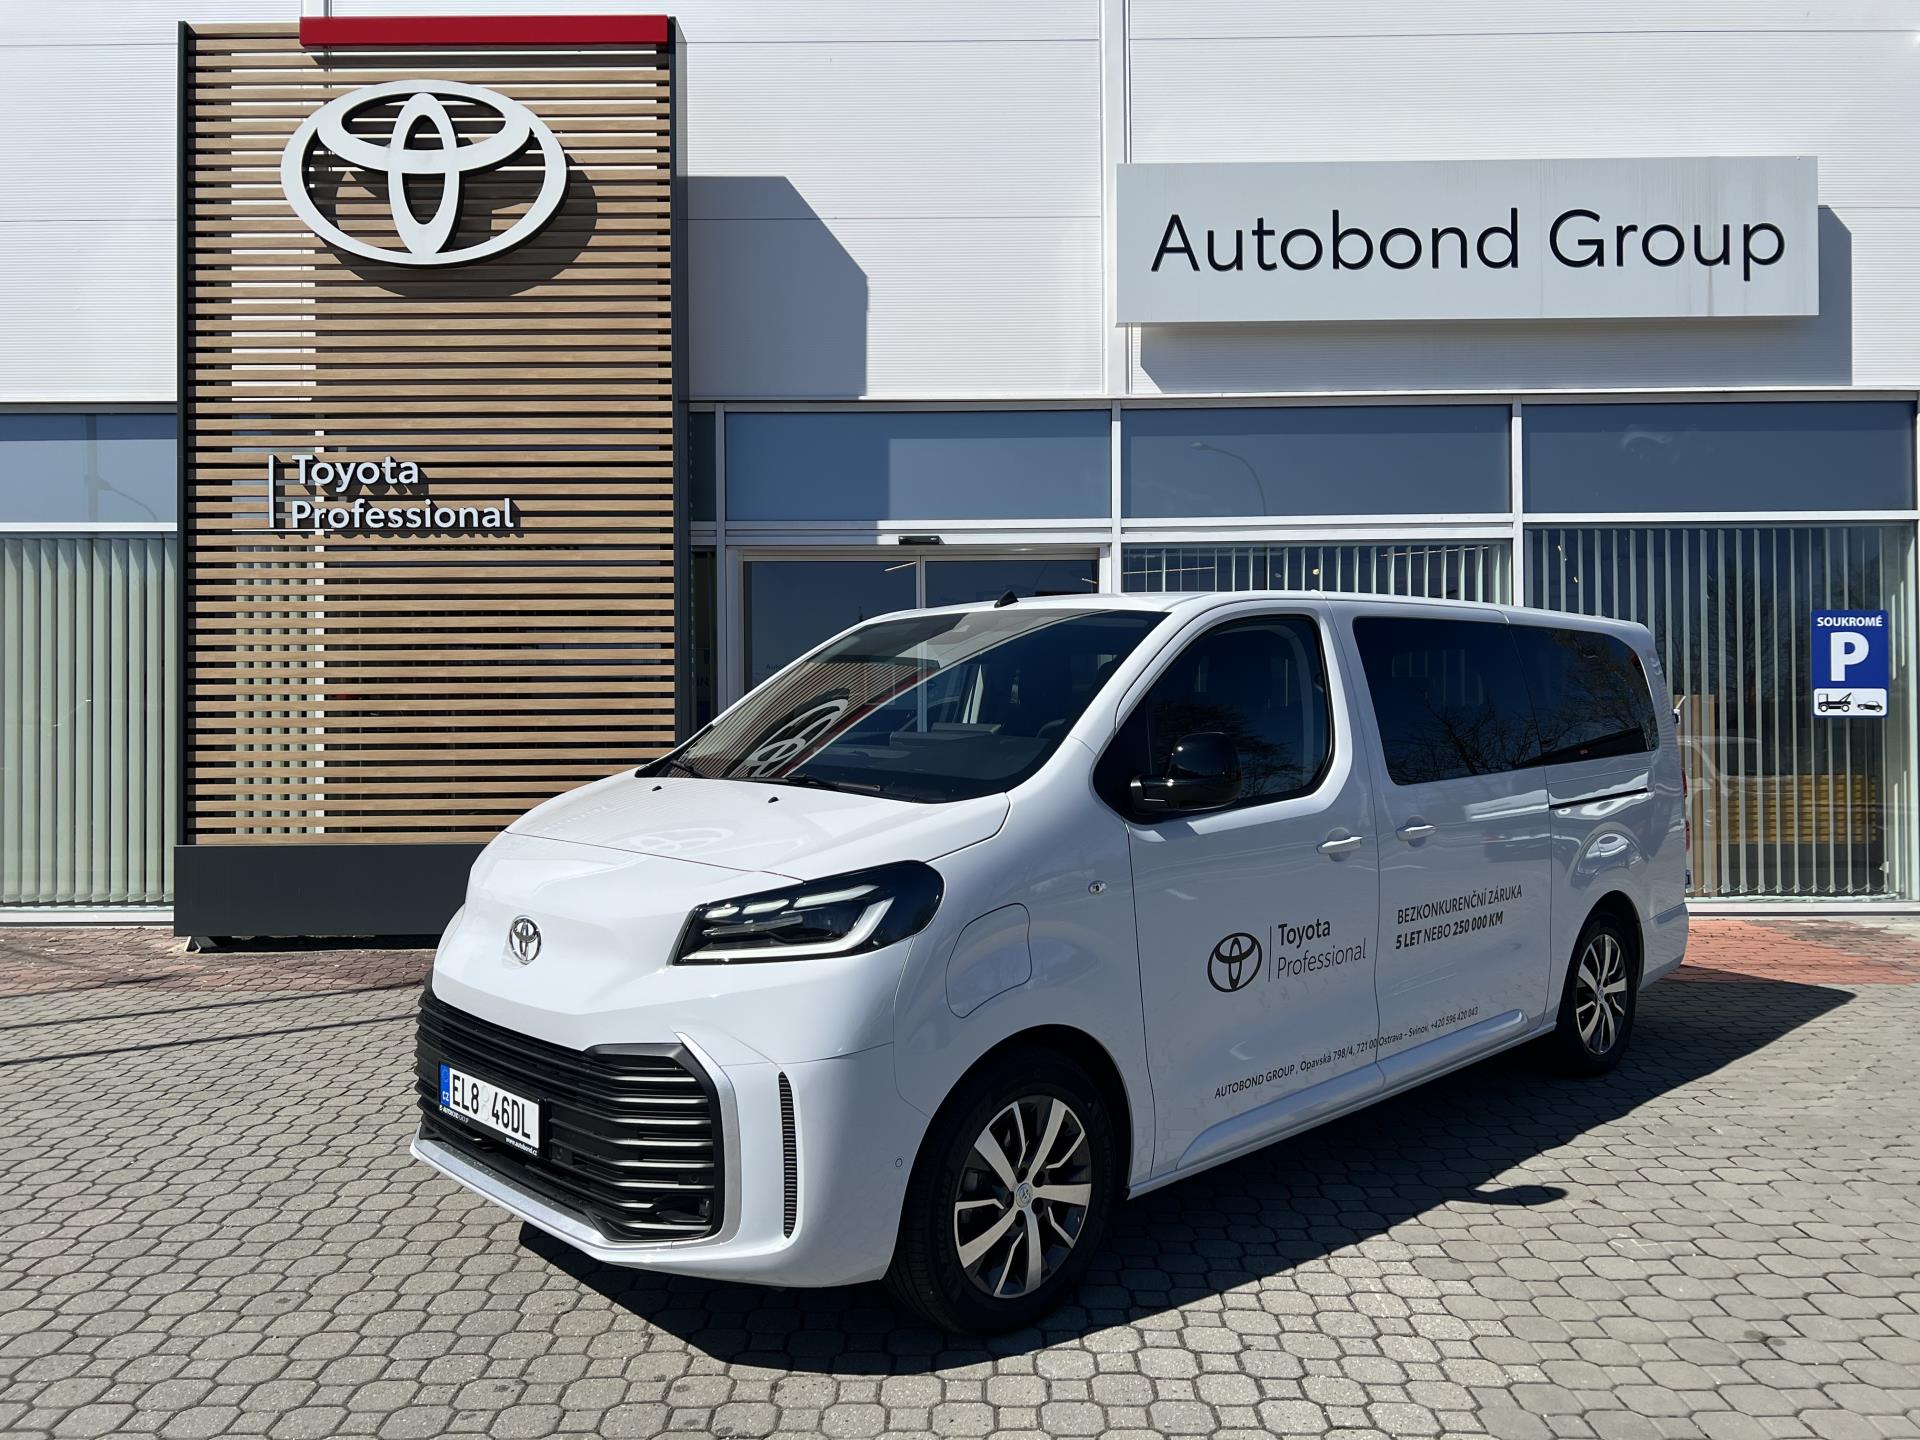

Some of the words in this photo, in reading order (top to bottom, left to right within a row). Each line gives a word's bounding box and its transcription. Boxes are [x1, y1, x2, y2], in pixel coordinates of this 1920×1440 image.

[1151, 207, 1519, 272] Autobond
[1549, 209, 1786, 282] Group
[292, 455, 419, 493] Toyota
[291, 498, 515, 529] Professional
[1817, 615, 1883, 627] SOUKROMÉ
[1830, 631, 1870, 682] P
[1397, 887, 1487, 925] BEZKONKURENČNÍ
[1488, 884, 1523, 905] ZÁRUKA
[1278, 918, 1330, 949] Toyota
[1395, 934, 1403, 950] 5
[1404, 929, 1422, 948] LET
[1423, 923, 1451, 943] NEBO
[1452, 918, 1470, 936] 250
[1471, 914, 1488, 932] 000
[1488, 910, 1504, 928] KM
[1277, 937, 1367, 980] Professional
[1214, 1074, 1265, 1099] AUTOBOND
[1265, 1064, 1295, 1082] GROUP
[1300, 1053, 1332, 1072] Opavská
[1333, 1045, 1355, 1061] 798/4,
[1378, 1033, 1403, 1047] Ostrava
[1408, 1024, 1430, 1038] Svinov,
[452, 1073, 479, 1115] EL8
[491, 1091, 531, 1140] 46DL
